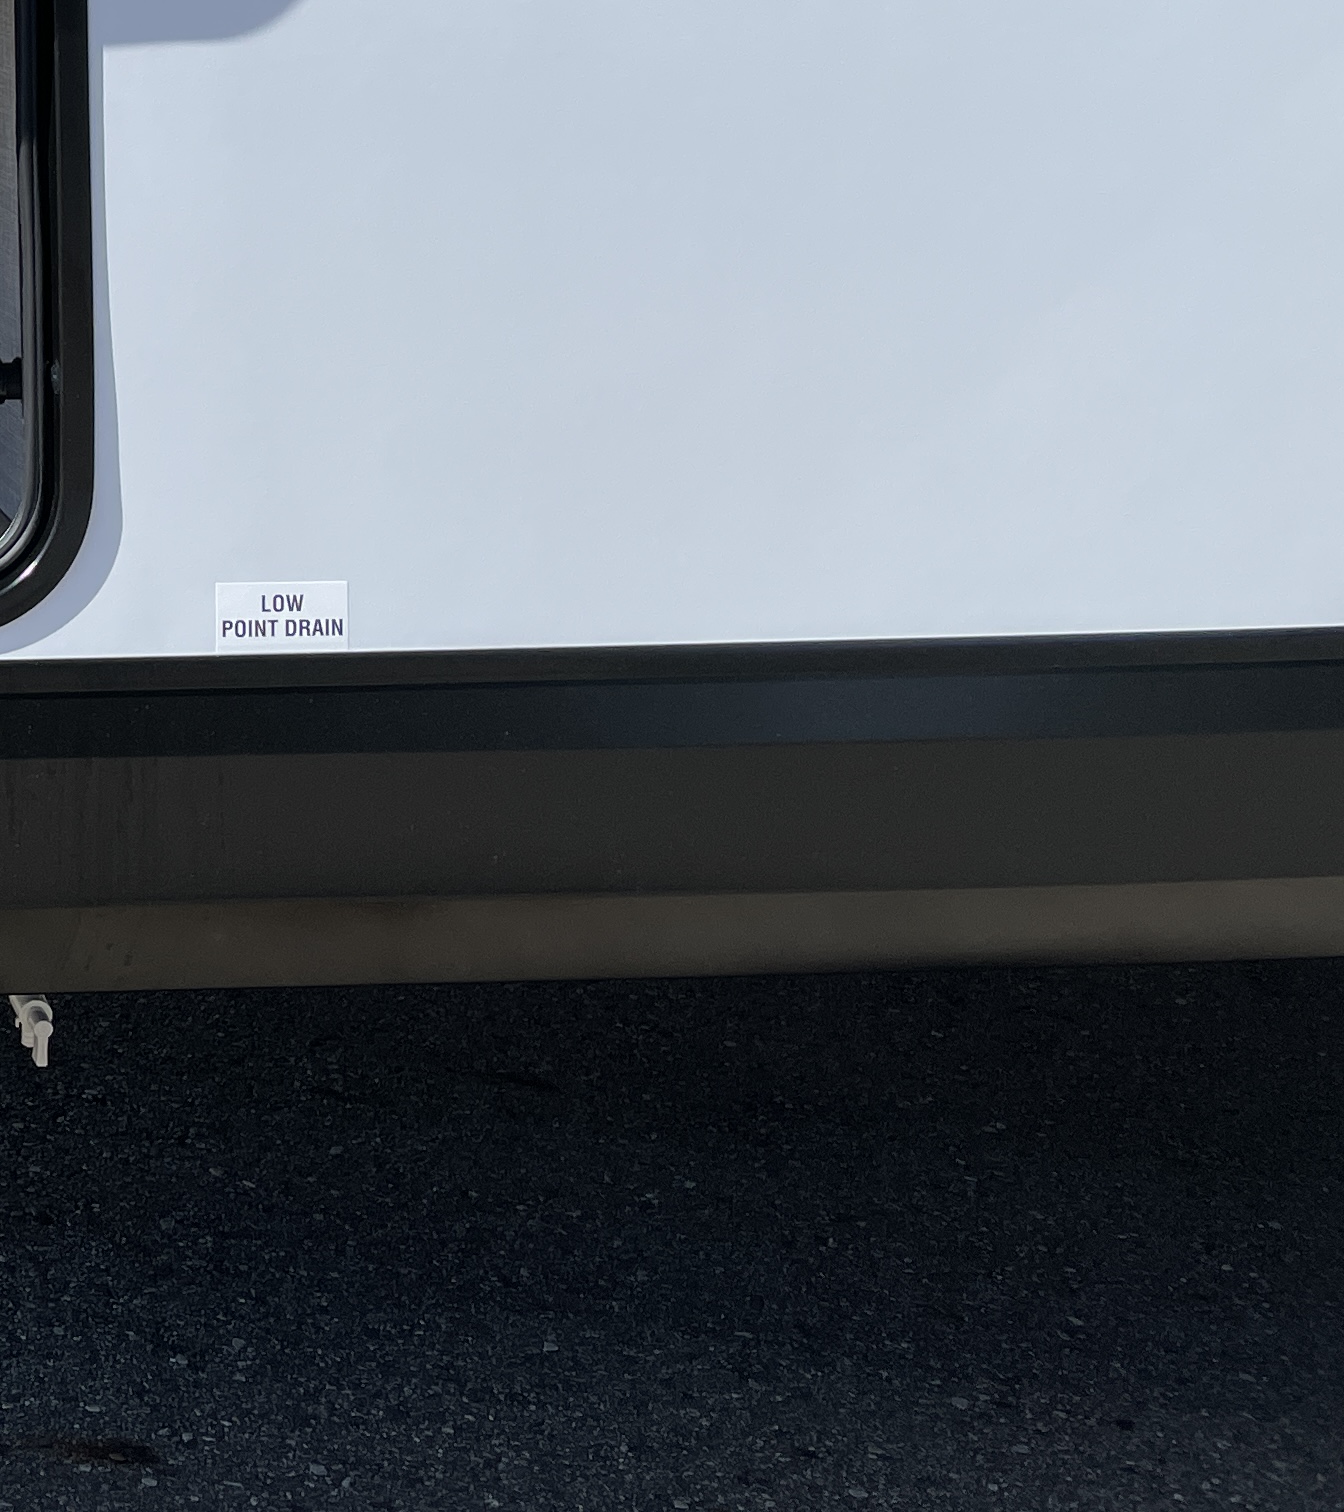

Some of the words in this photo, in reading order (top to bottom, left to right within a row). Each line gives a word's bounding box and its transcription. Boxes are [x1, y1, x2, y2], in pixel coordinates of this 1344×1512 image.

[261, 594, 304, 612] LOW
[222, 619, 278, 638] POINT
[285, 618, 343, 637] DRAIN
